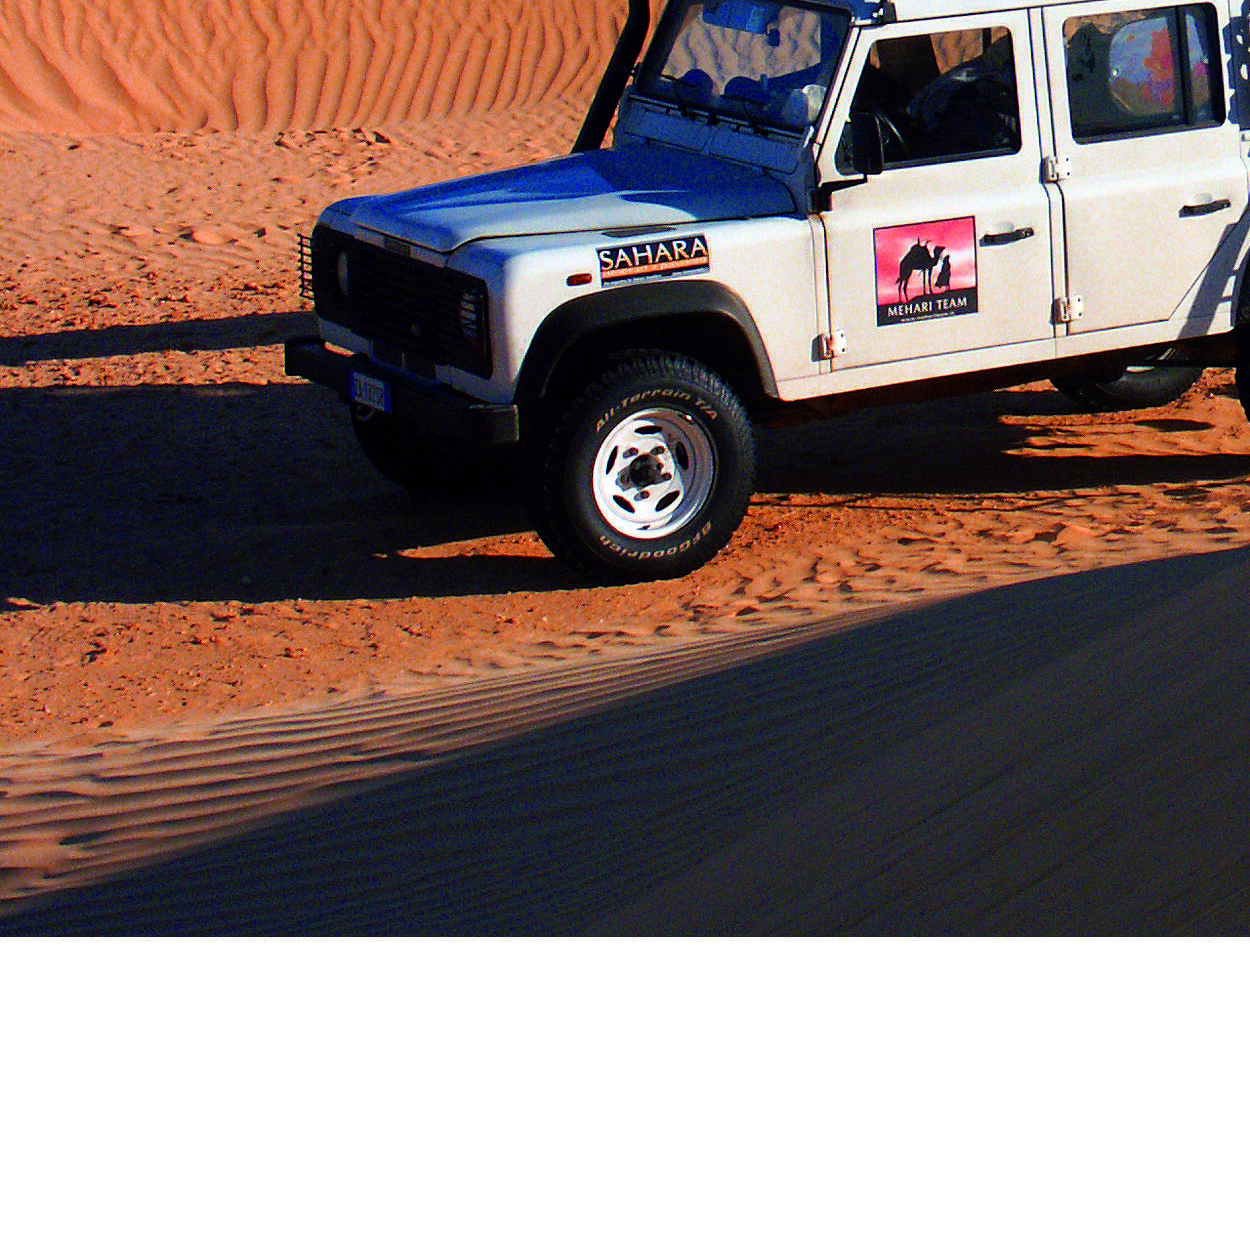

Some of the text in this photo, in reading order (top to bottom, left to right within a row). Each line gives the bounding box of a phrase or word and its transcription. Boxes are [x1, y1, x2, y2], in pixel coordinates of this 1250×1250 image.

[599, 237, 709, 271] SAHARA
[887, 300, 933, 318] MEHARI
[935, 296, 968, 311] TEAM
